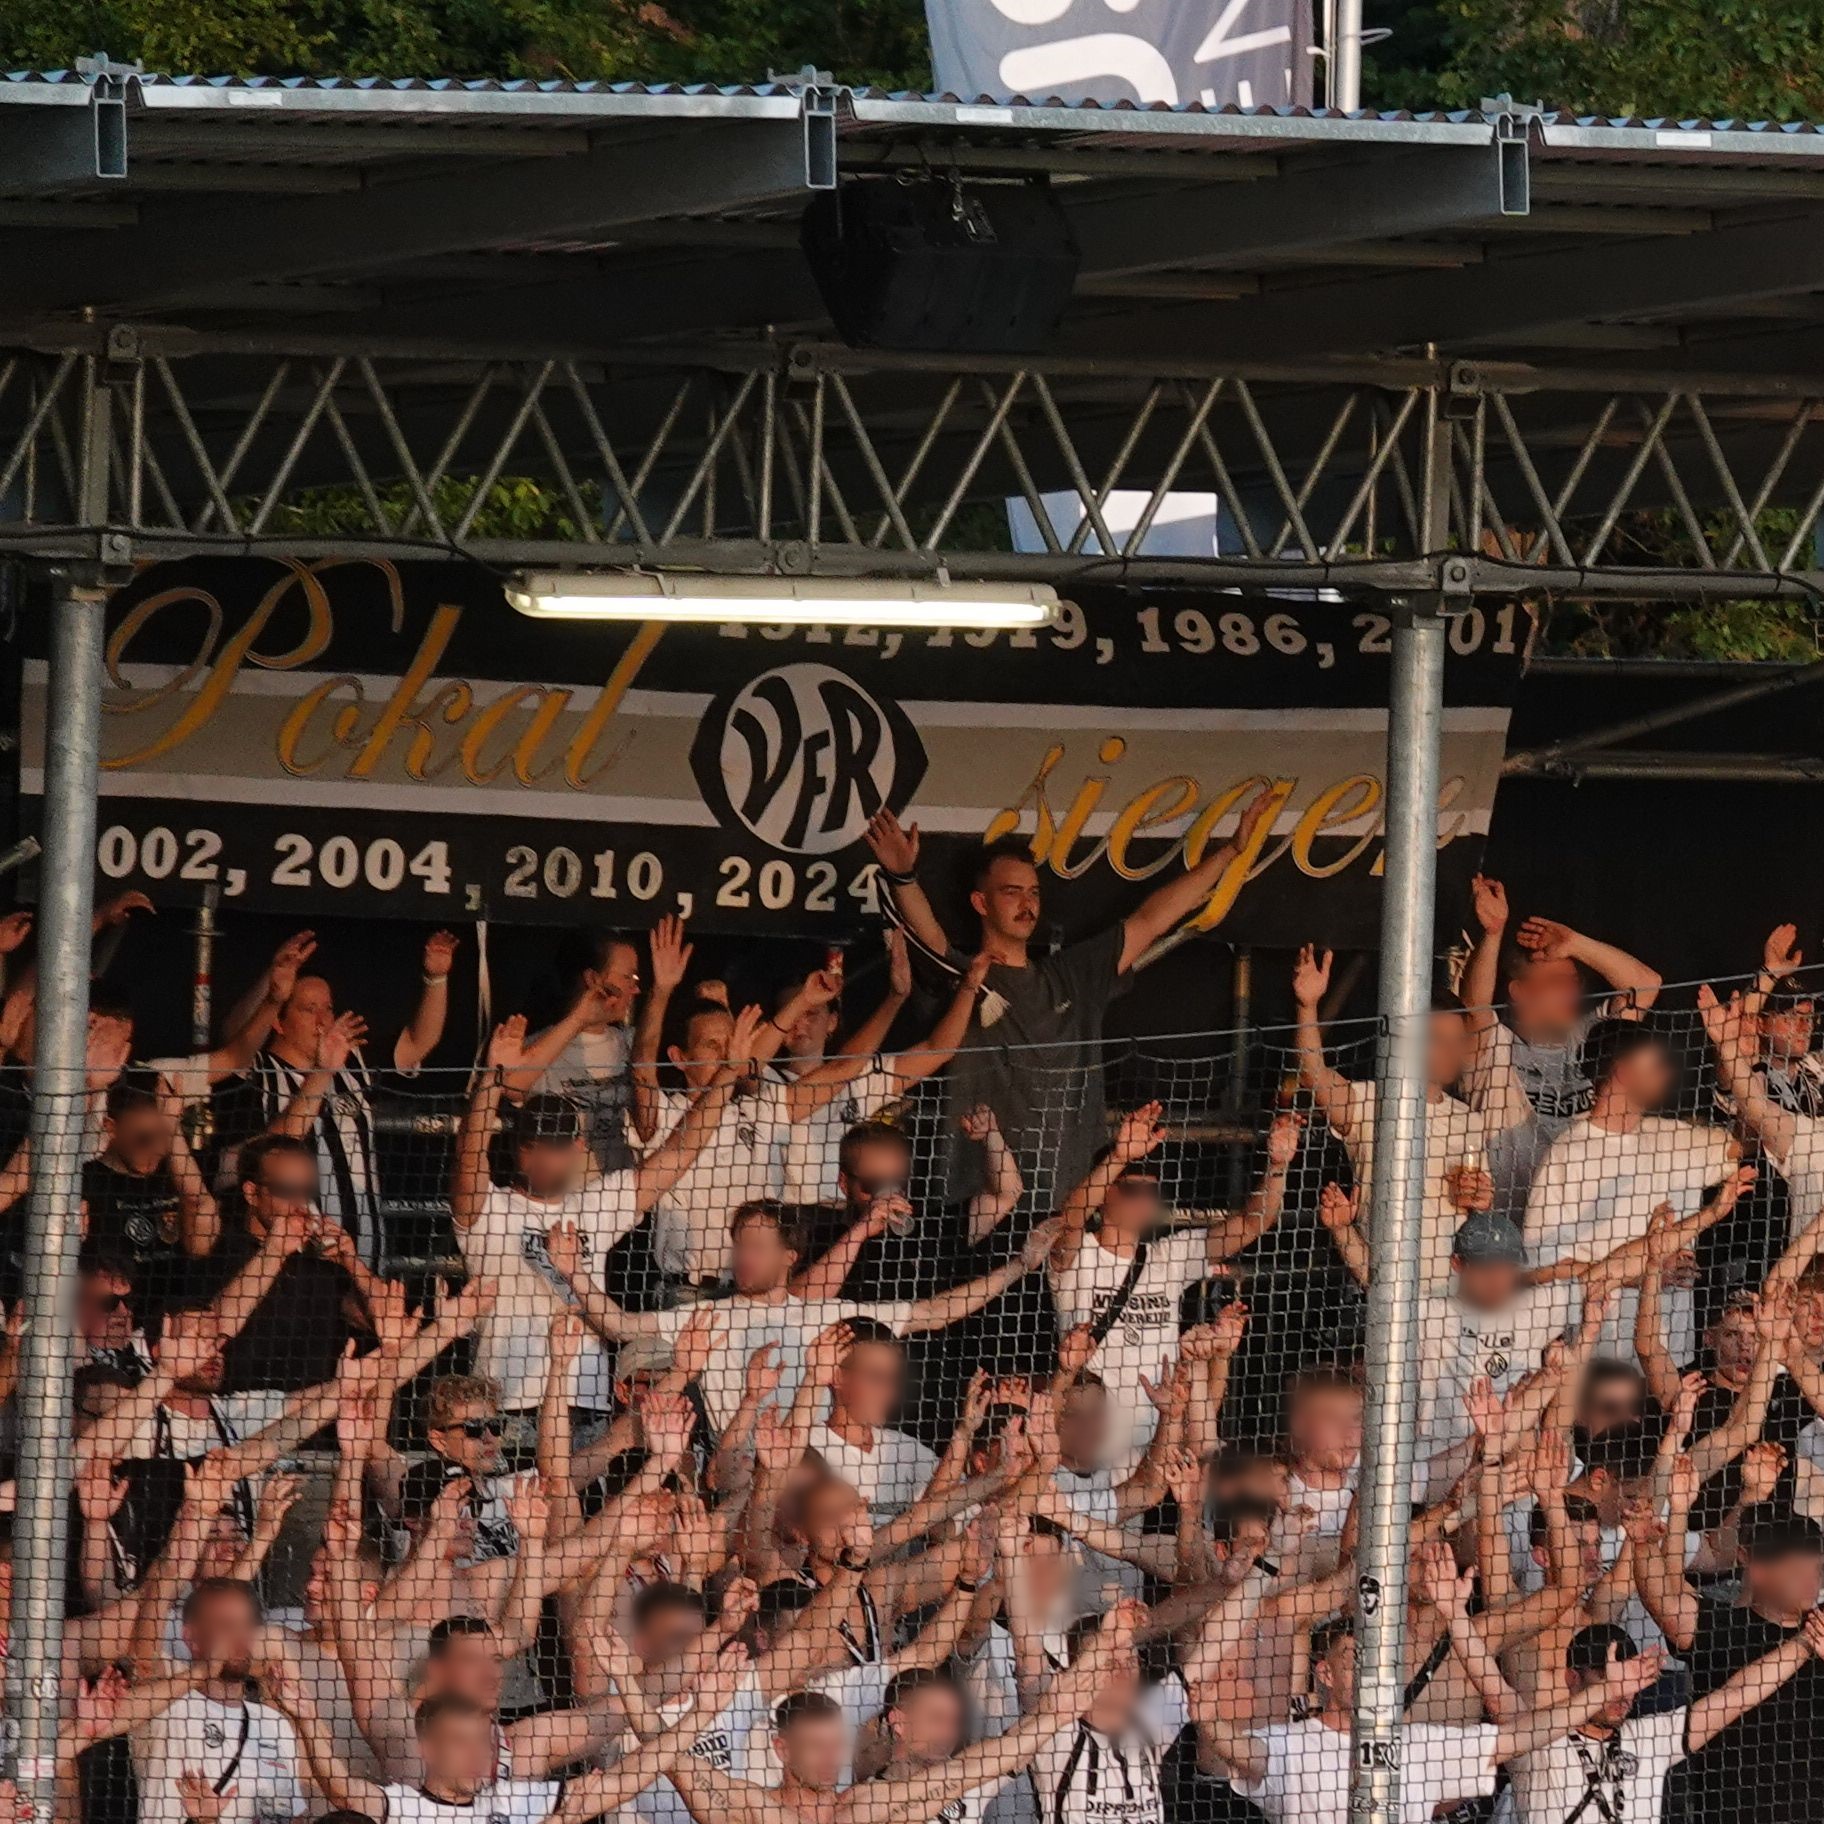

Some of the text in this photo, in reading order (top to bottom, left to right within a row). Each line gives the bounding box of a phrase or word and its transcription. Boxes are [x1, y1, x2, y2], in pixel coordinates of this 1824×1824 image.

[98, 555, 638, 793] Pokal
[1137, 605, 1336, 669] 1986,
[1352, 598, 1523, 656] 201
[100, 824, 885, 921] 002, 2004, 2010, 2024
